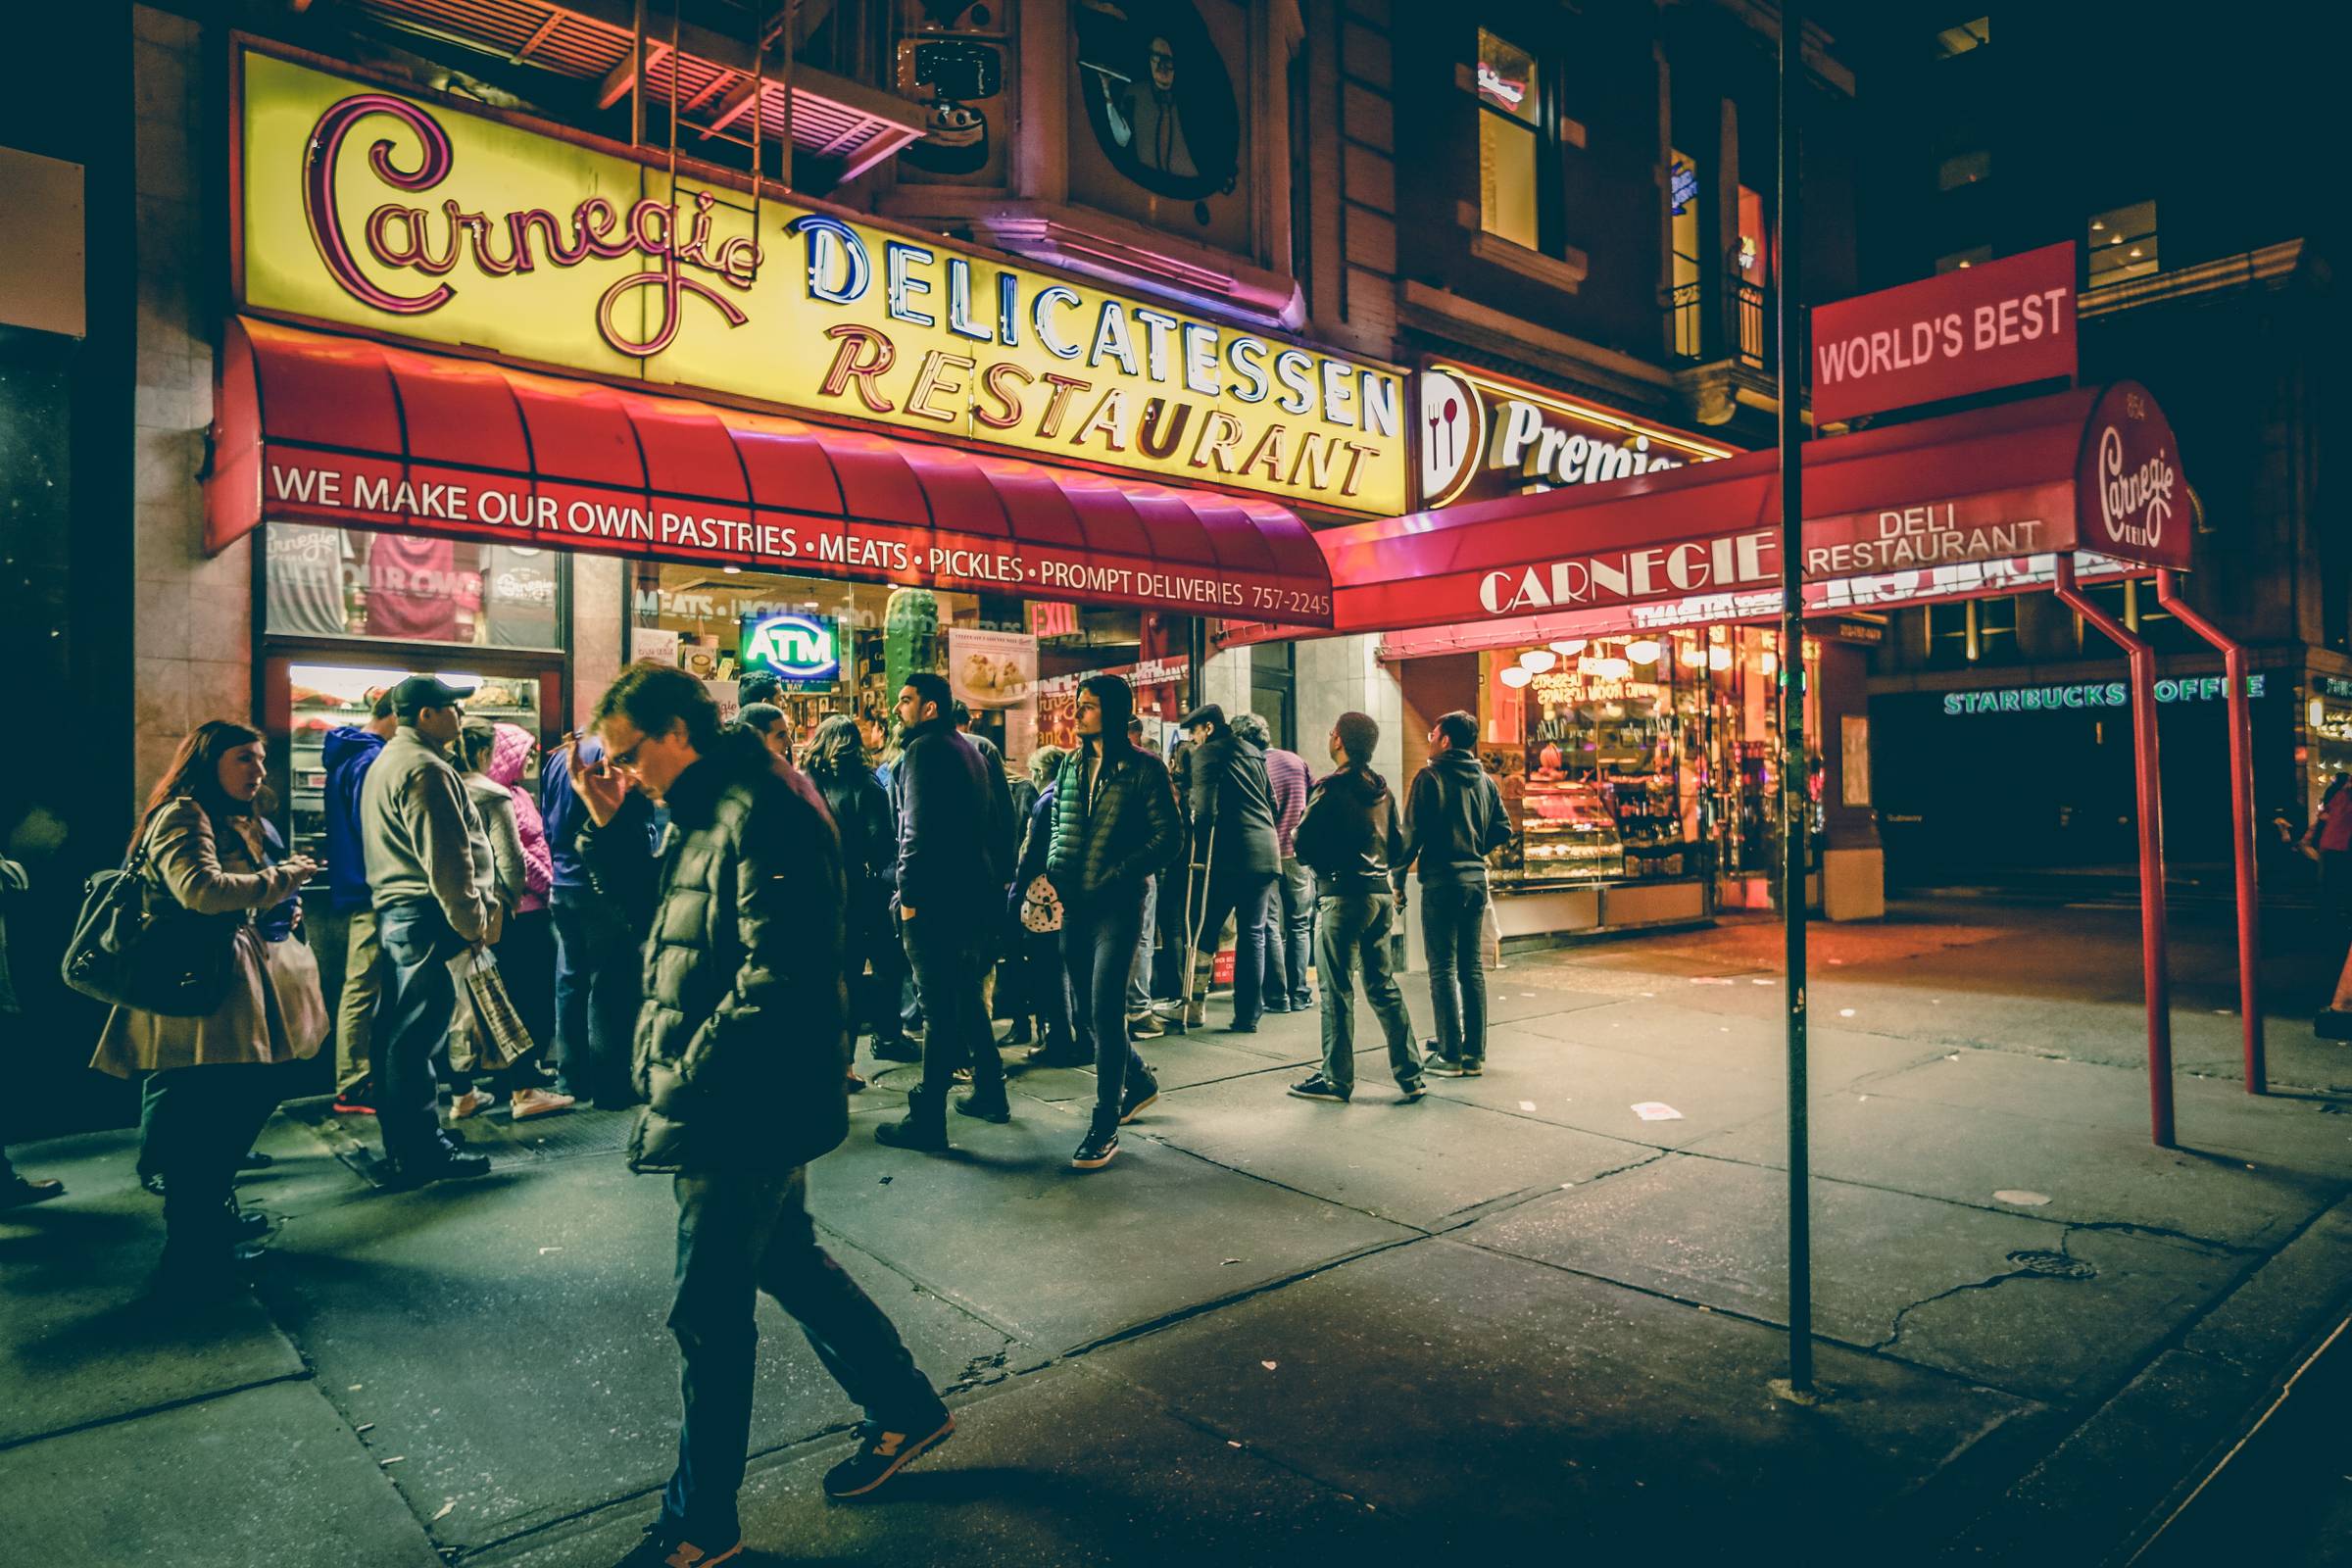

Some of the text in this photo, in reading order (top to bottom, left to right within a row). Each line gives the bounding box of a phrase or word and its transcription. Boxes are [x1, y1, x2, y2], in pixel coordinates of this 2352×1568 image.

[302, 94, 764, 357] Carnegie
[785, 213, 1396, 438] DELICATESSEN
[1819, 287, 2067, 385] WORLD'S BEST
[819, 323, 1380, 497] RESTAURANT
[1492, 401, 1683, 484] Premi
[1880, 503, 1955, 540] DELI
[2099, 426, 2175, 548] Carnegie
[271, 466, 1331, 616] WE MAKE OUR OWN PASTRIES MEATS PICKLES PROMPT DELIVERIES 757-2245
[1479, 531, 1781, 614] CARNEGIE
[1807, 519, 2042, 574] RESTAURANT
[747, 628, 832, 662] ATM
[1031, 602, 1073, 638] EXIT
[1944, 674, 2266, 715] STARBUCKS OFFE
